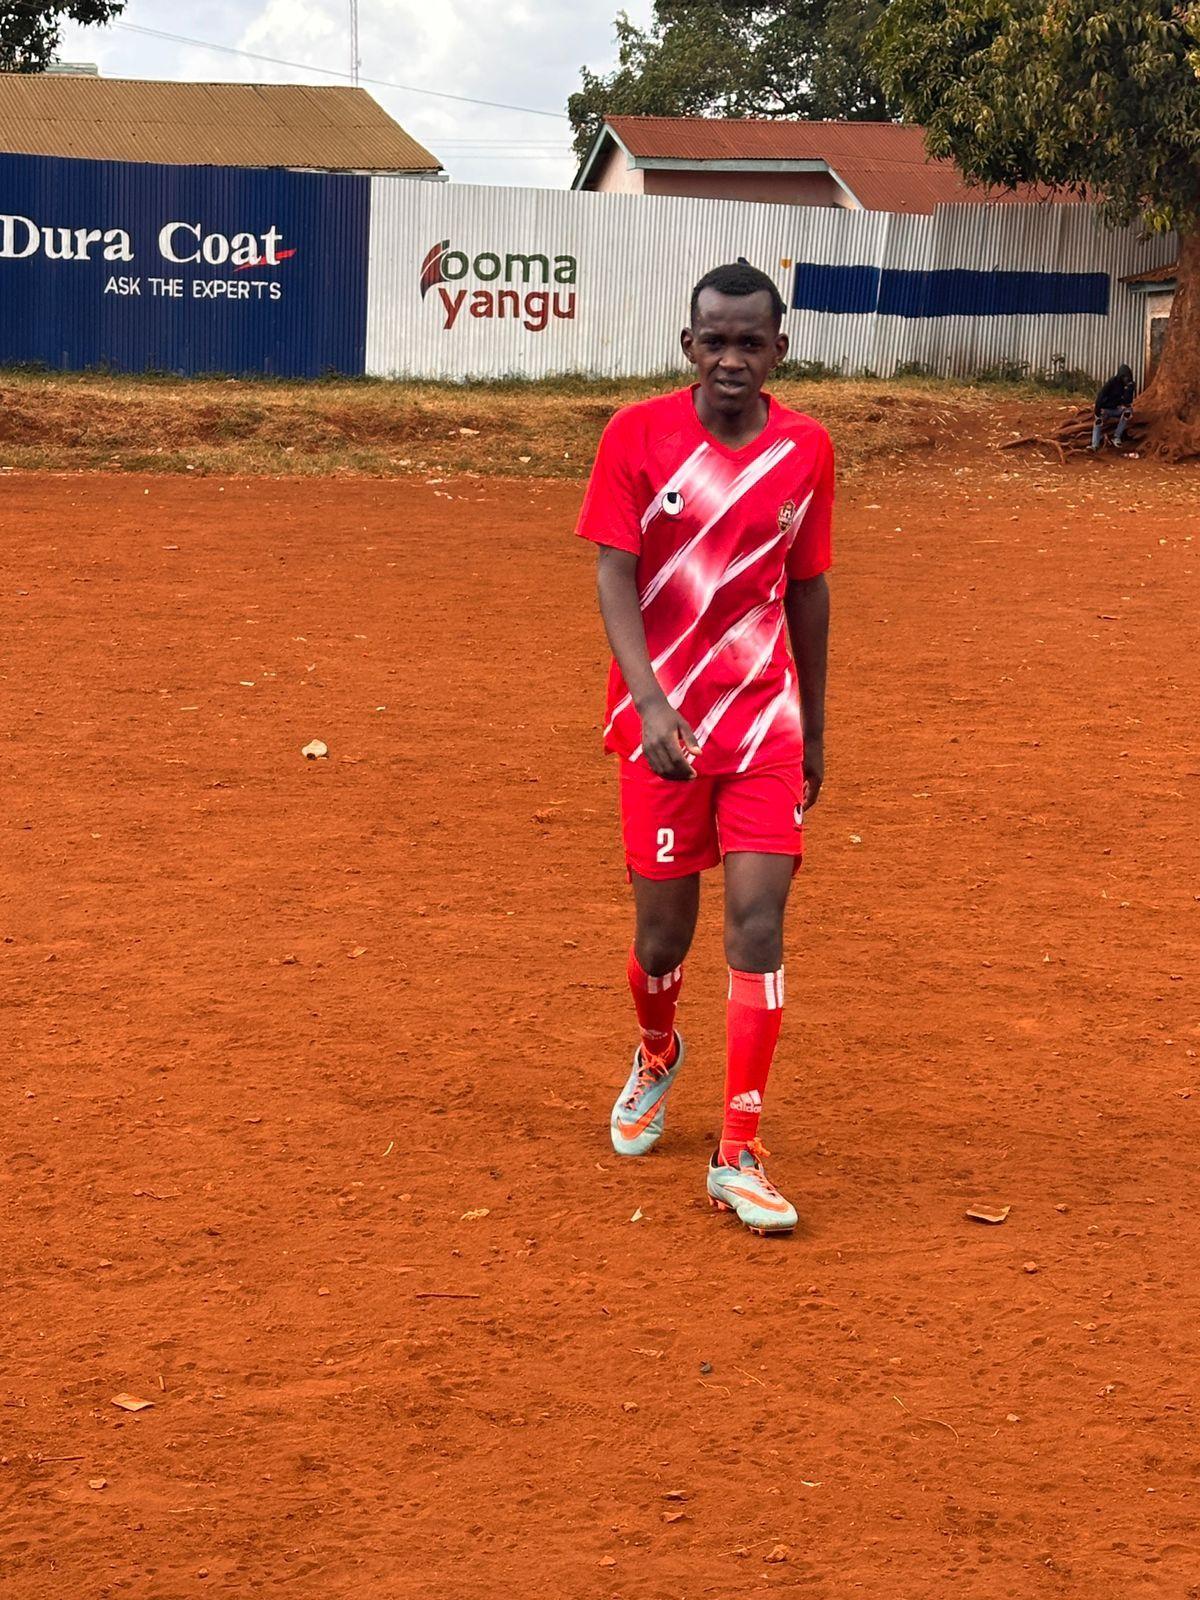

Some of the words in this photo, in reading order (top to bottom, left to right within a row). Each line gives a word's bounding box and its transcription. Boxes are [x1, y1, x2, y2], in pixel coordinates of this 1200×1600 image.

[0, 214, 134, 261] Dura
[158, 222, 283, 266] Coat
[104, 276, 141, 296] ASK
[148, 277, 183, 297] THE
[192, 280, 282, 300] EXPERTS
[438, 287, 576, 332] yangu
[656, 827, 675, 863] 2
